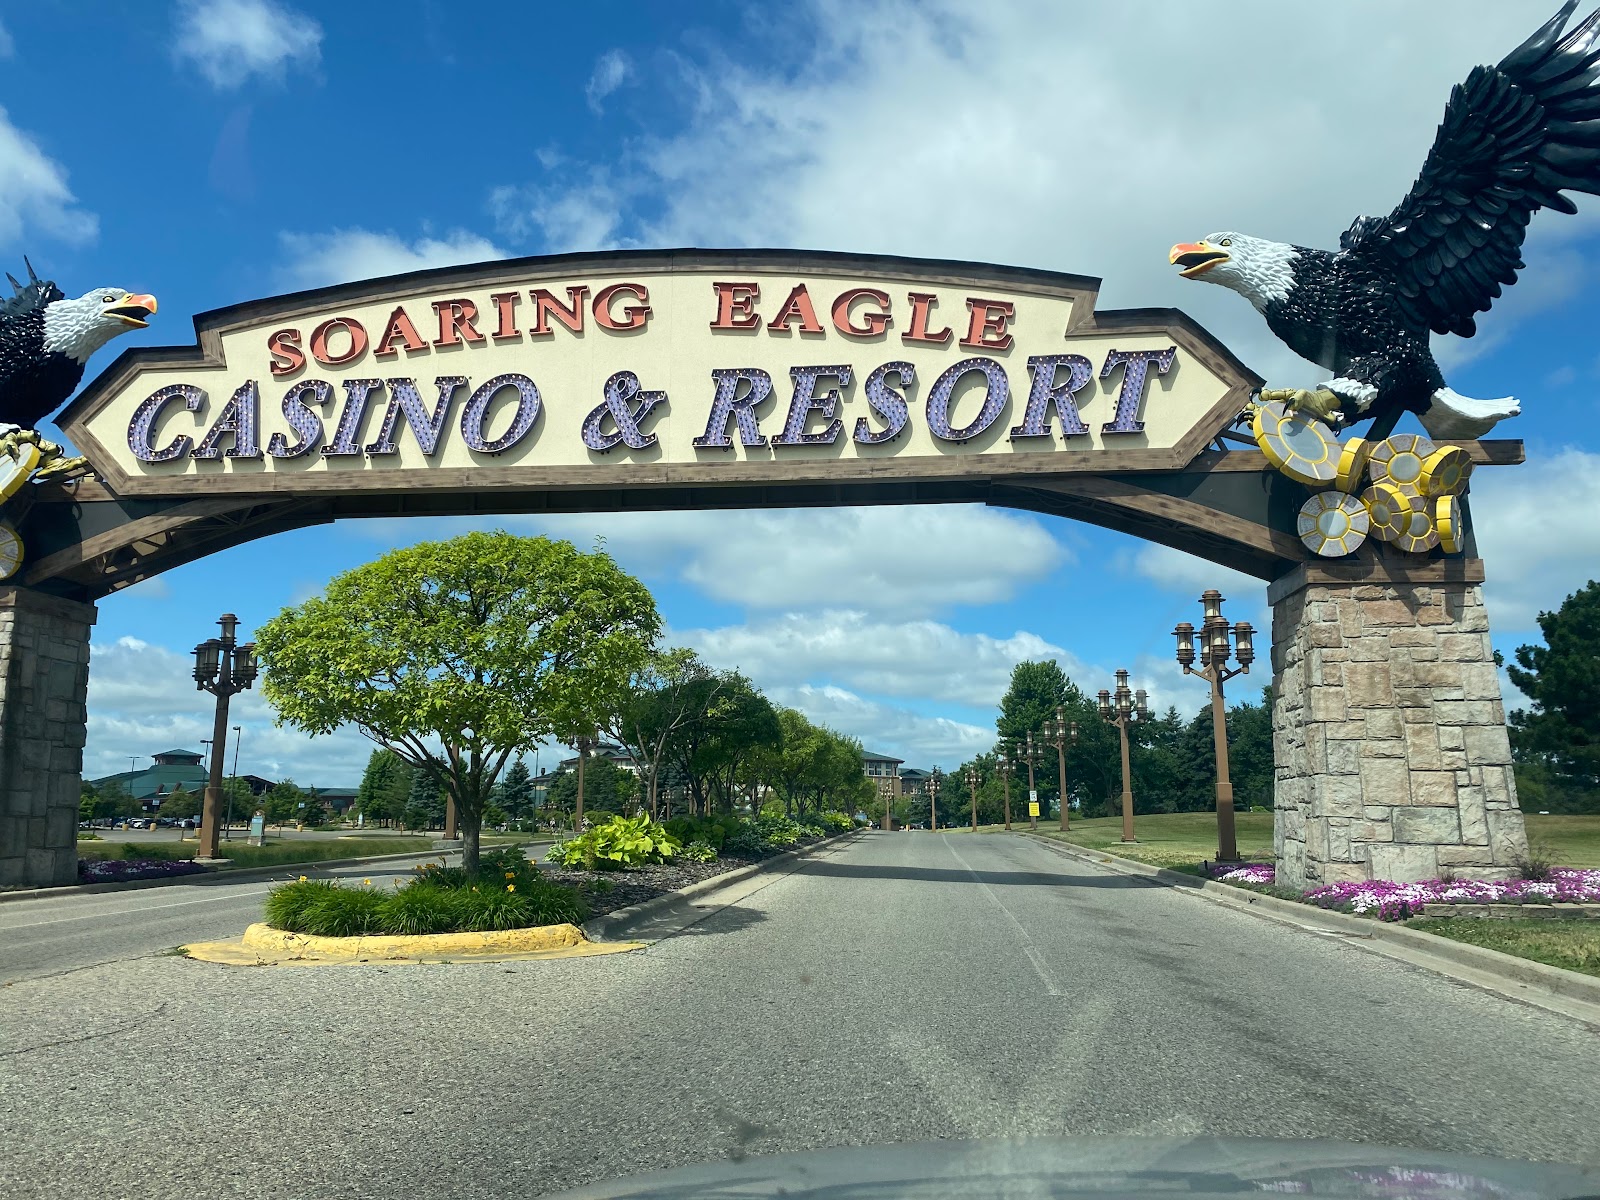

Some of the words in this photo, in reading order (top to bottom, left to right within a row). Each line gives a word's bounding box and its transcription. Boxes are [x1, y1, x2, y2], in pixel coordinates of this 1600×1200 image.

[267, 283, 651, 376] SOARING
[709, 281, 1015, 351] EAGLE
[126, 373, 543, 464] CASINO
[581, 370, 668, 451] &
[692, 345, 1178, 450] RESORT
